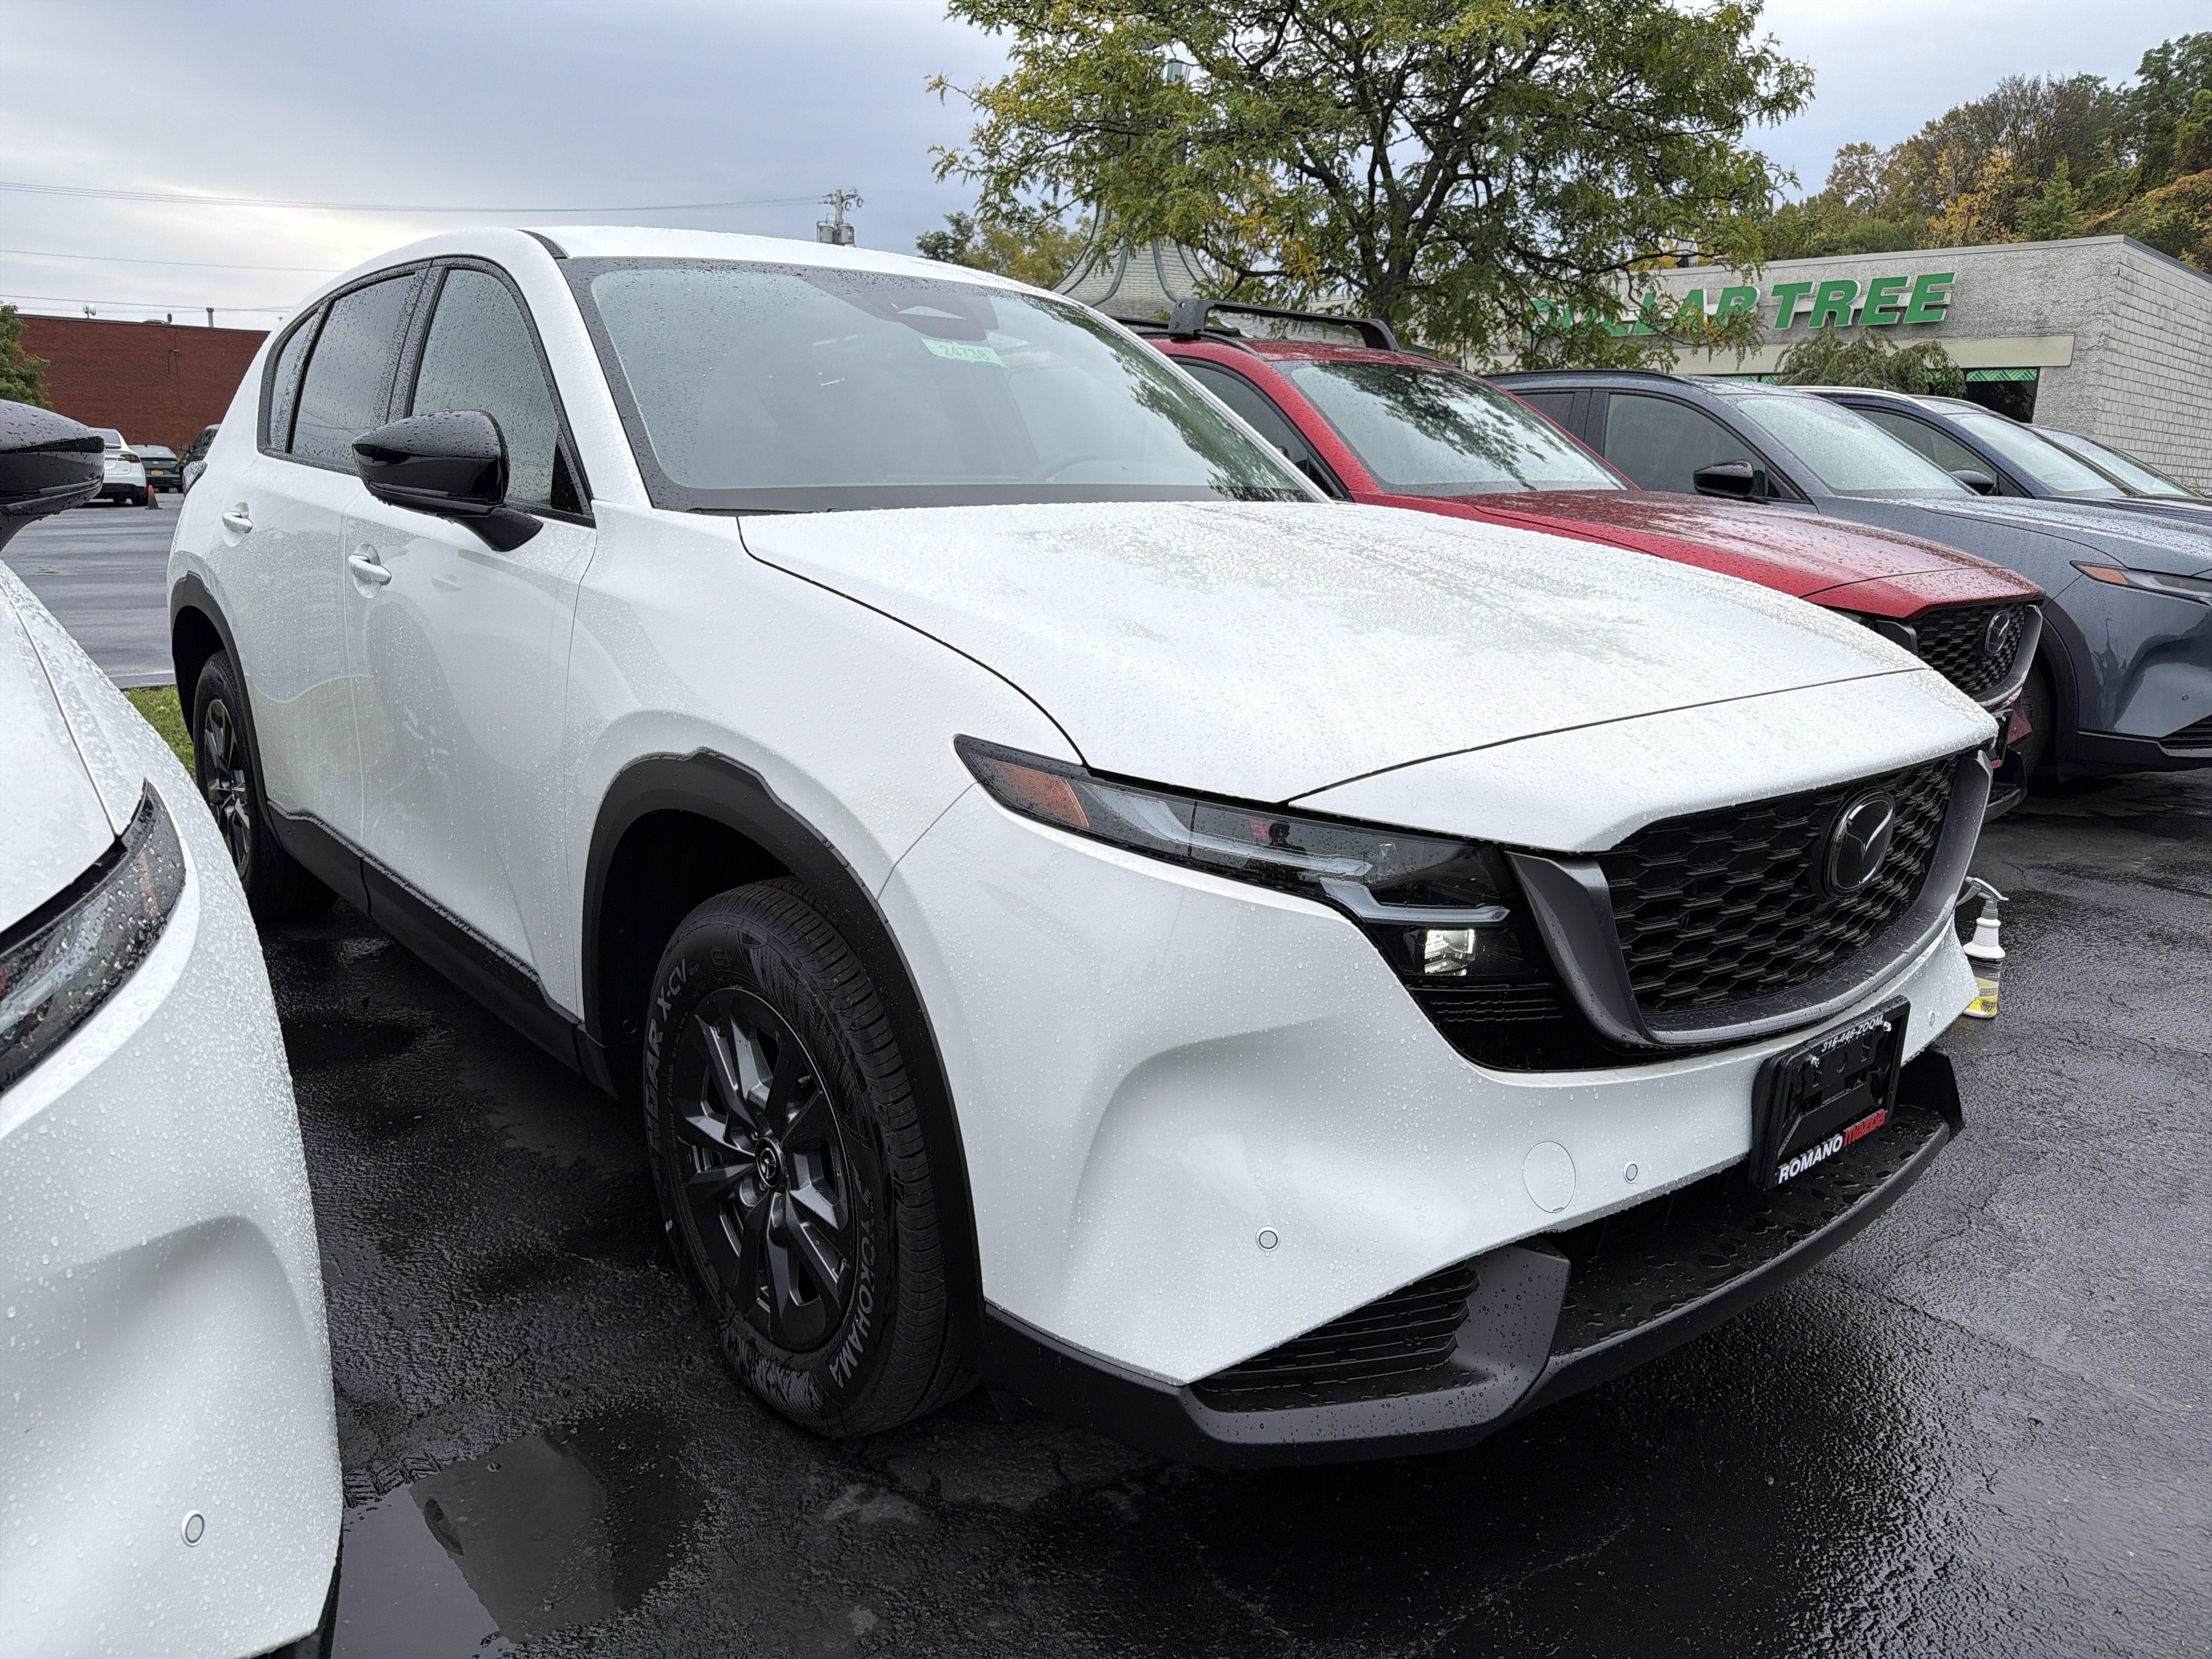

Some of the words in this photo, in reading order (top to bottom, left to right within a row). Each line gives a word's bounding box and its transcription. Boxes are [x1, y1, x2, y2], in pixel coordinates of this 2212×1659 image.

[1773, 272, 1957, 329] TREE
[938, 344, 991, 361] 24738
[1821, 1014, 1884, 1053] 315-446-ZOOM
[1778, 1135, 1843, 1184] ROMANO
[829, 1217, 877, 1389] YOKOHAMA
